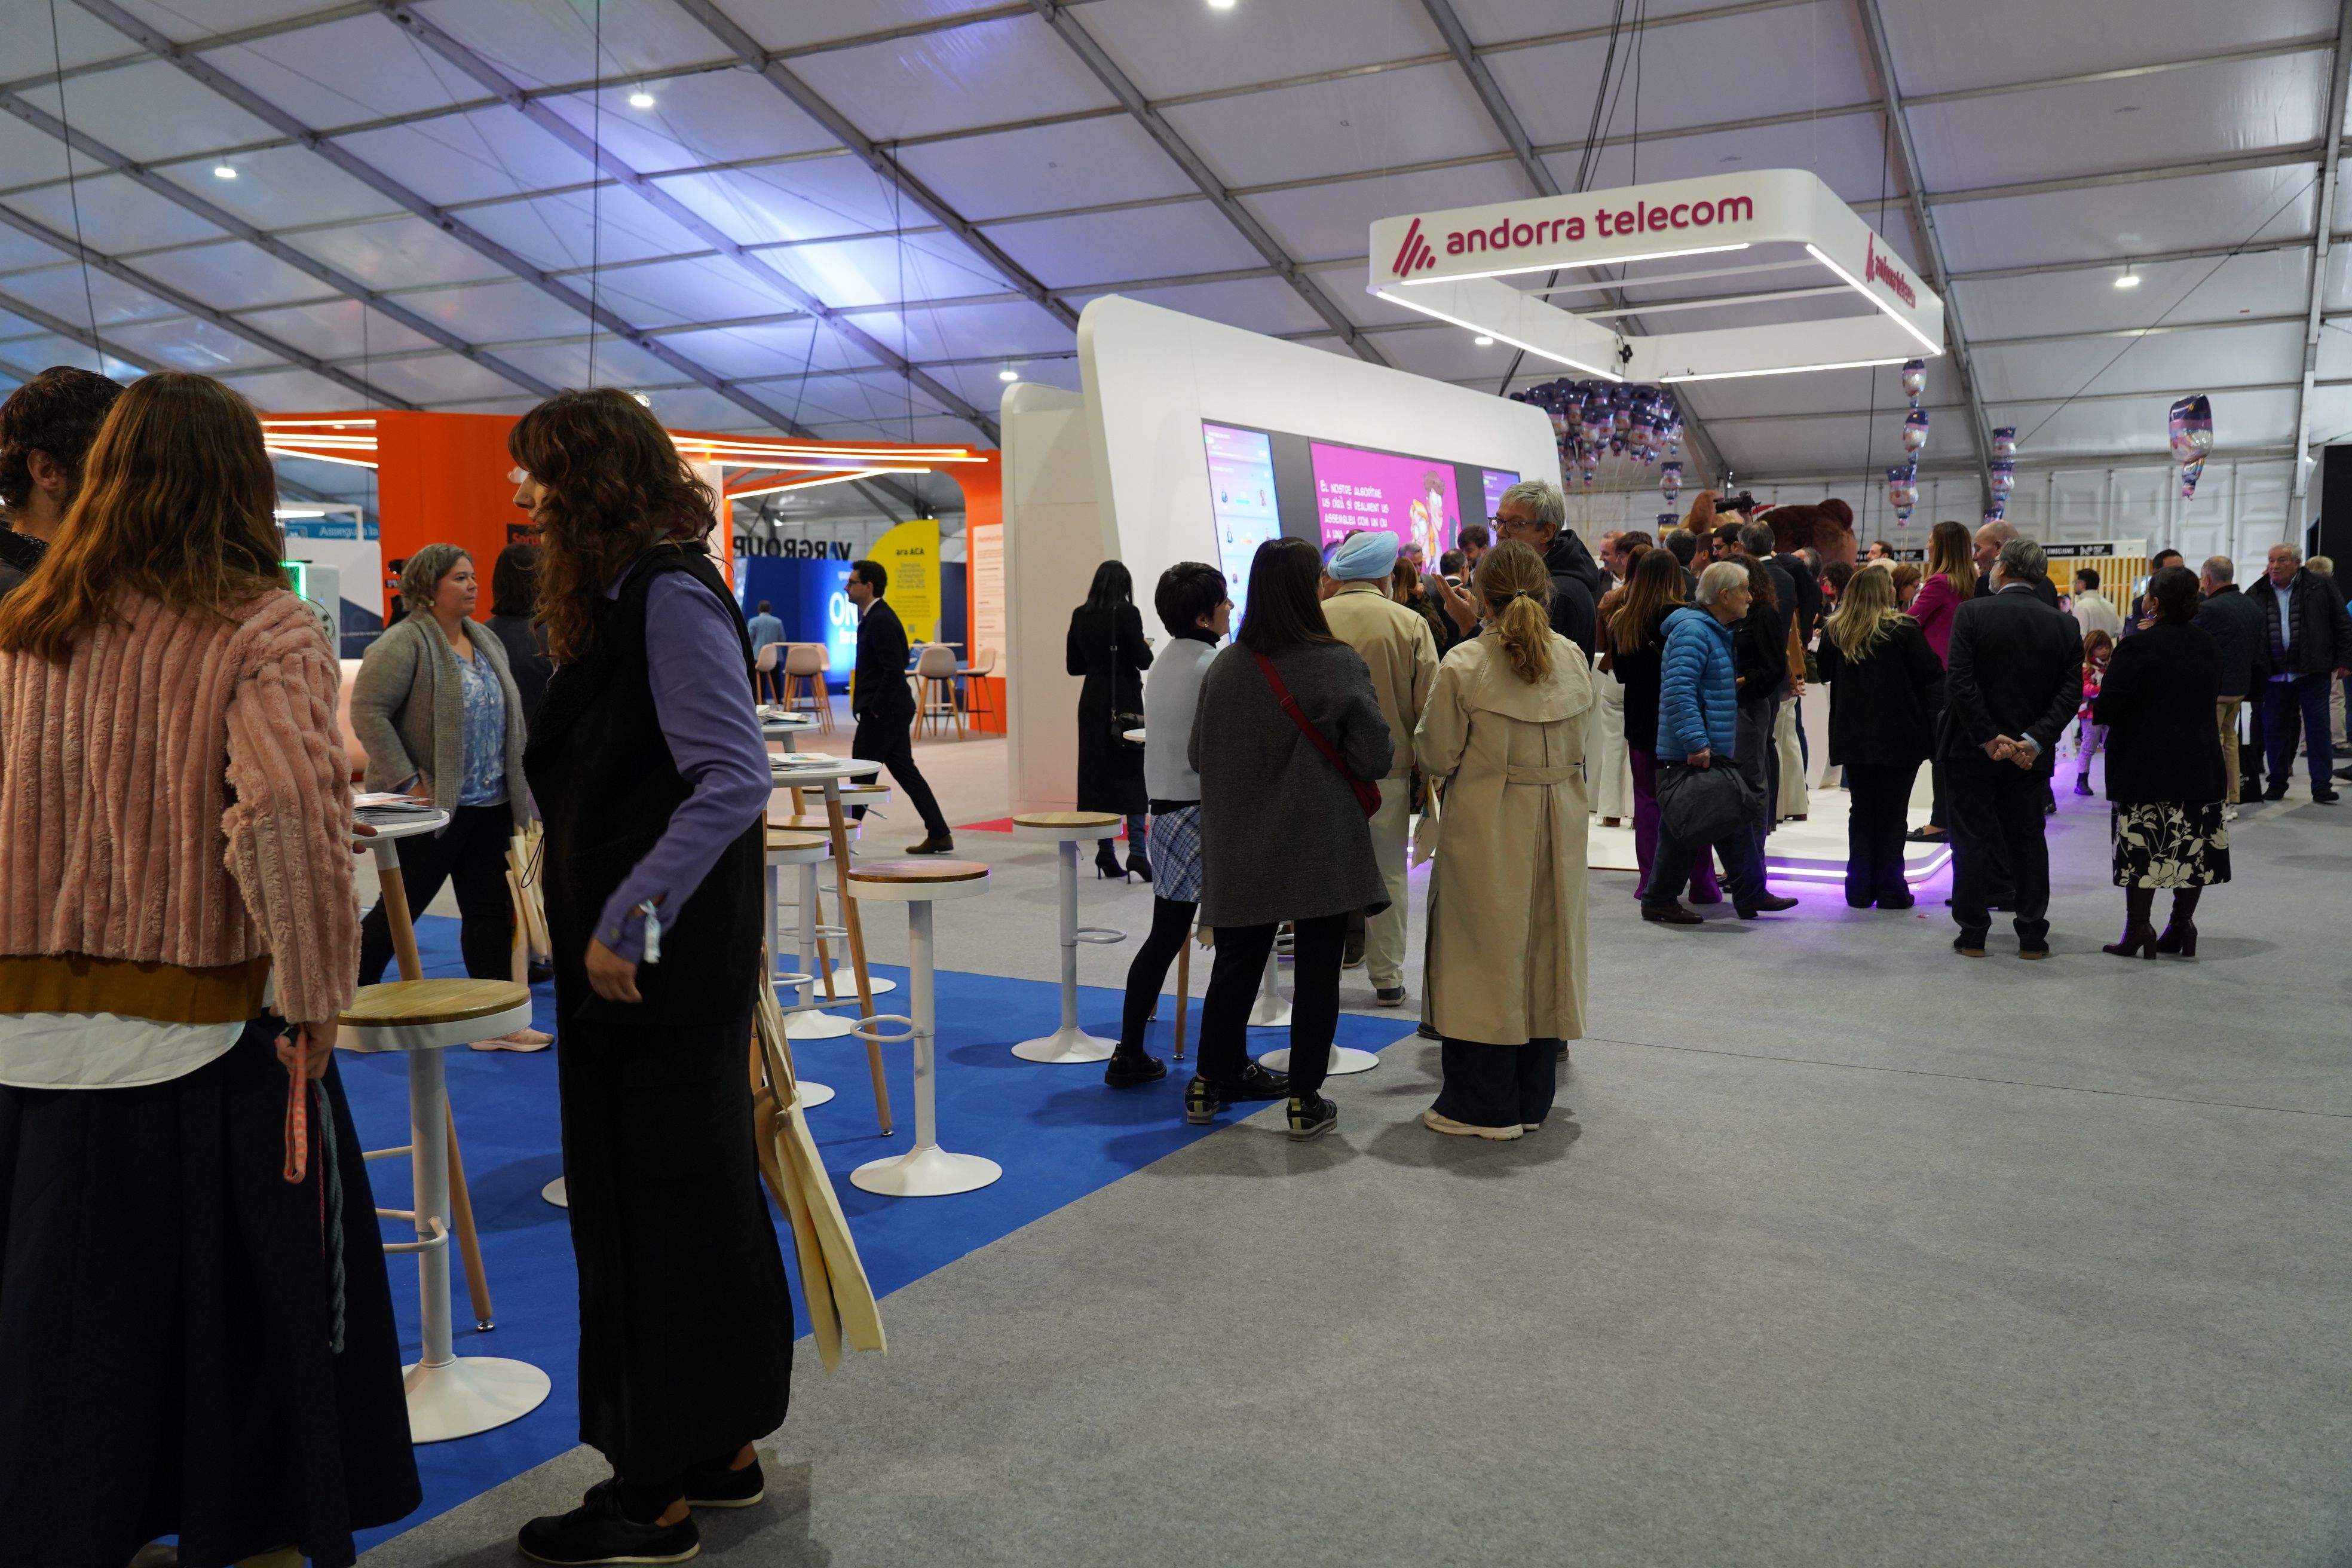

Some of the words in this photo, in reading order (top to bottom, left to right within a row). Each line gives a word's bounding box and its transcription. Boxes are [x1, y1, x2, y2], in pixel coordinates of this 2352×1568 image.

[1446, 218, 1585, 256] andorra
[1595, 195, 1753, 237] telecom
[1875, 255, 1895, 292] andorra
[1896, 271, 1916, 309] telecom
[829, 592, 859, 626] ON
